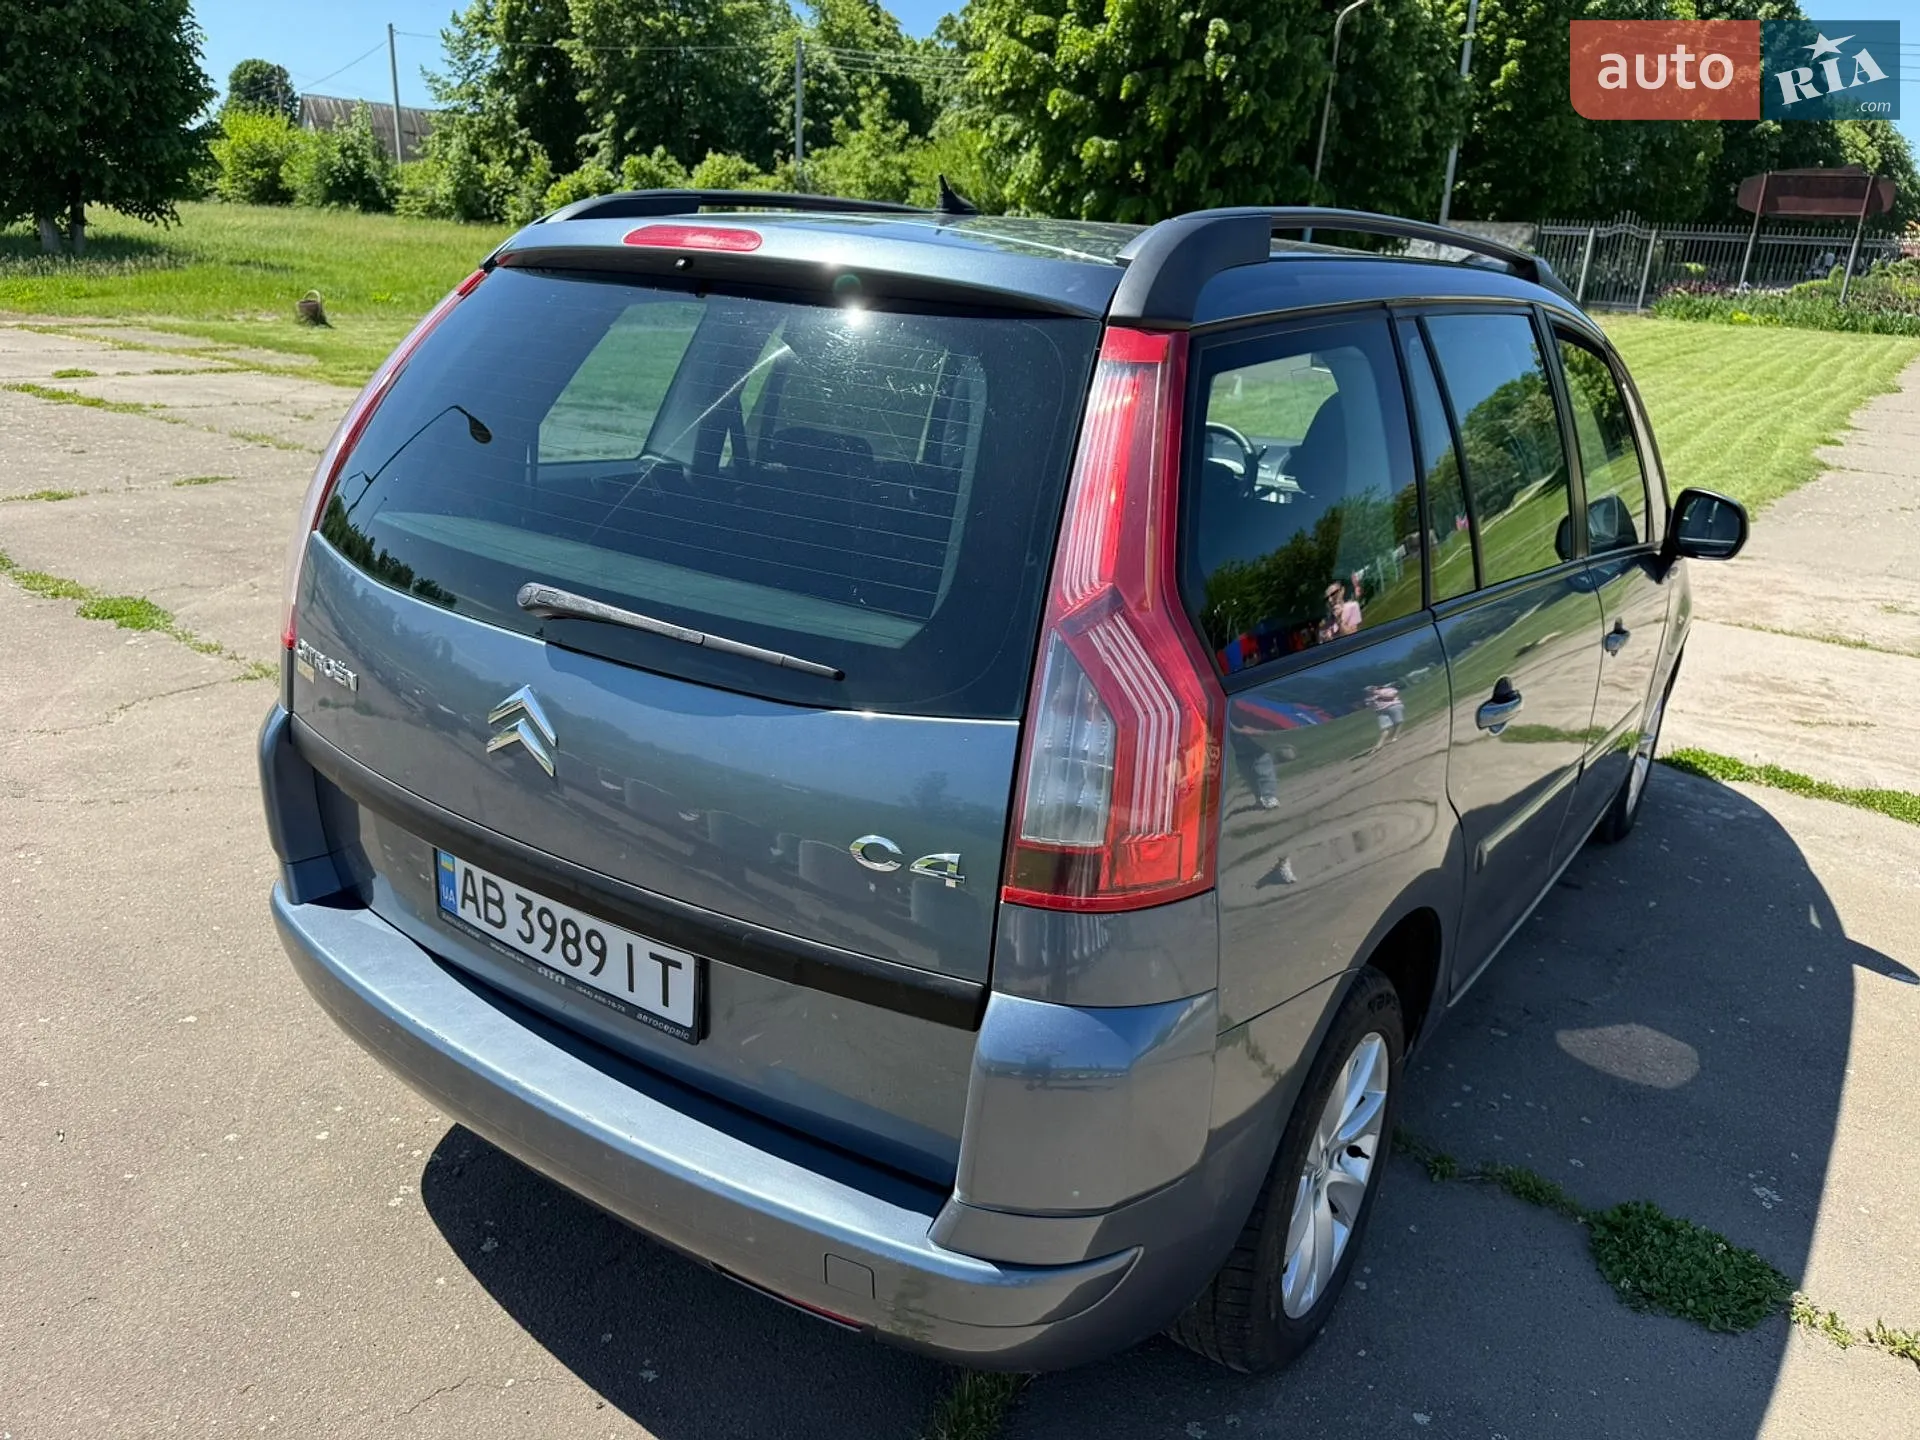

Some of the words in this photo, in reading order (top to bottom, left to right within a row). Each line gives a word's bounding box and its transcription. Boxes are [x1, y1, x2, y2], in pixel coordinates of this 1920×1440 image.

[849, 834, 966, 888] C4
[441, 884, 456, 904] UA
[460, 867, 507, 930] AB
[515, 893, 608, 977] 3989
[626, 943, 683, 1008] IT
